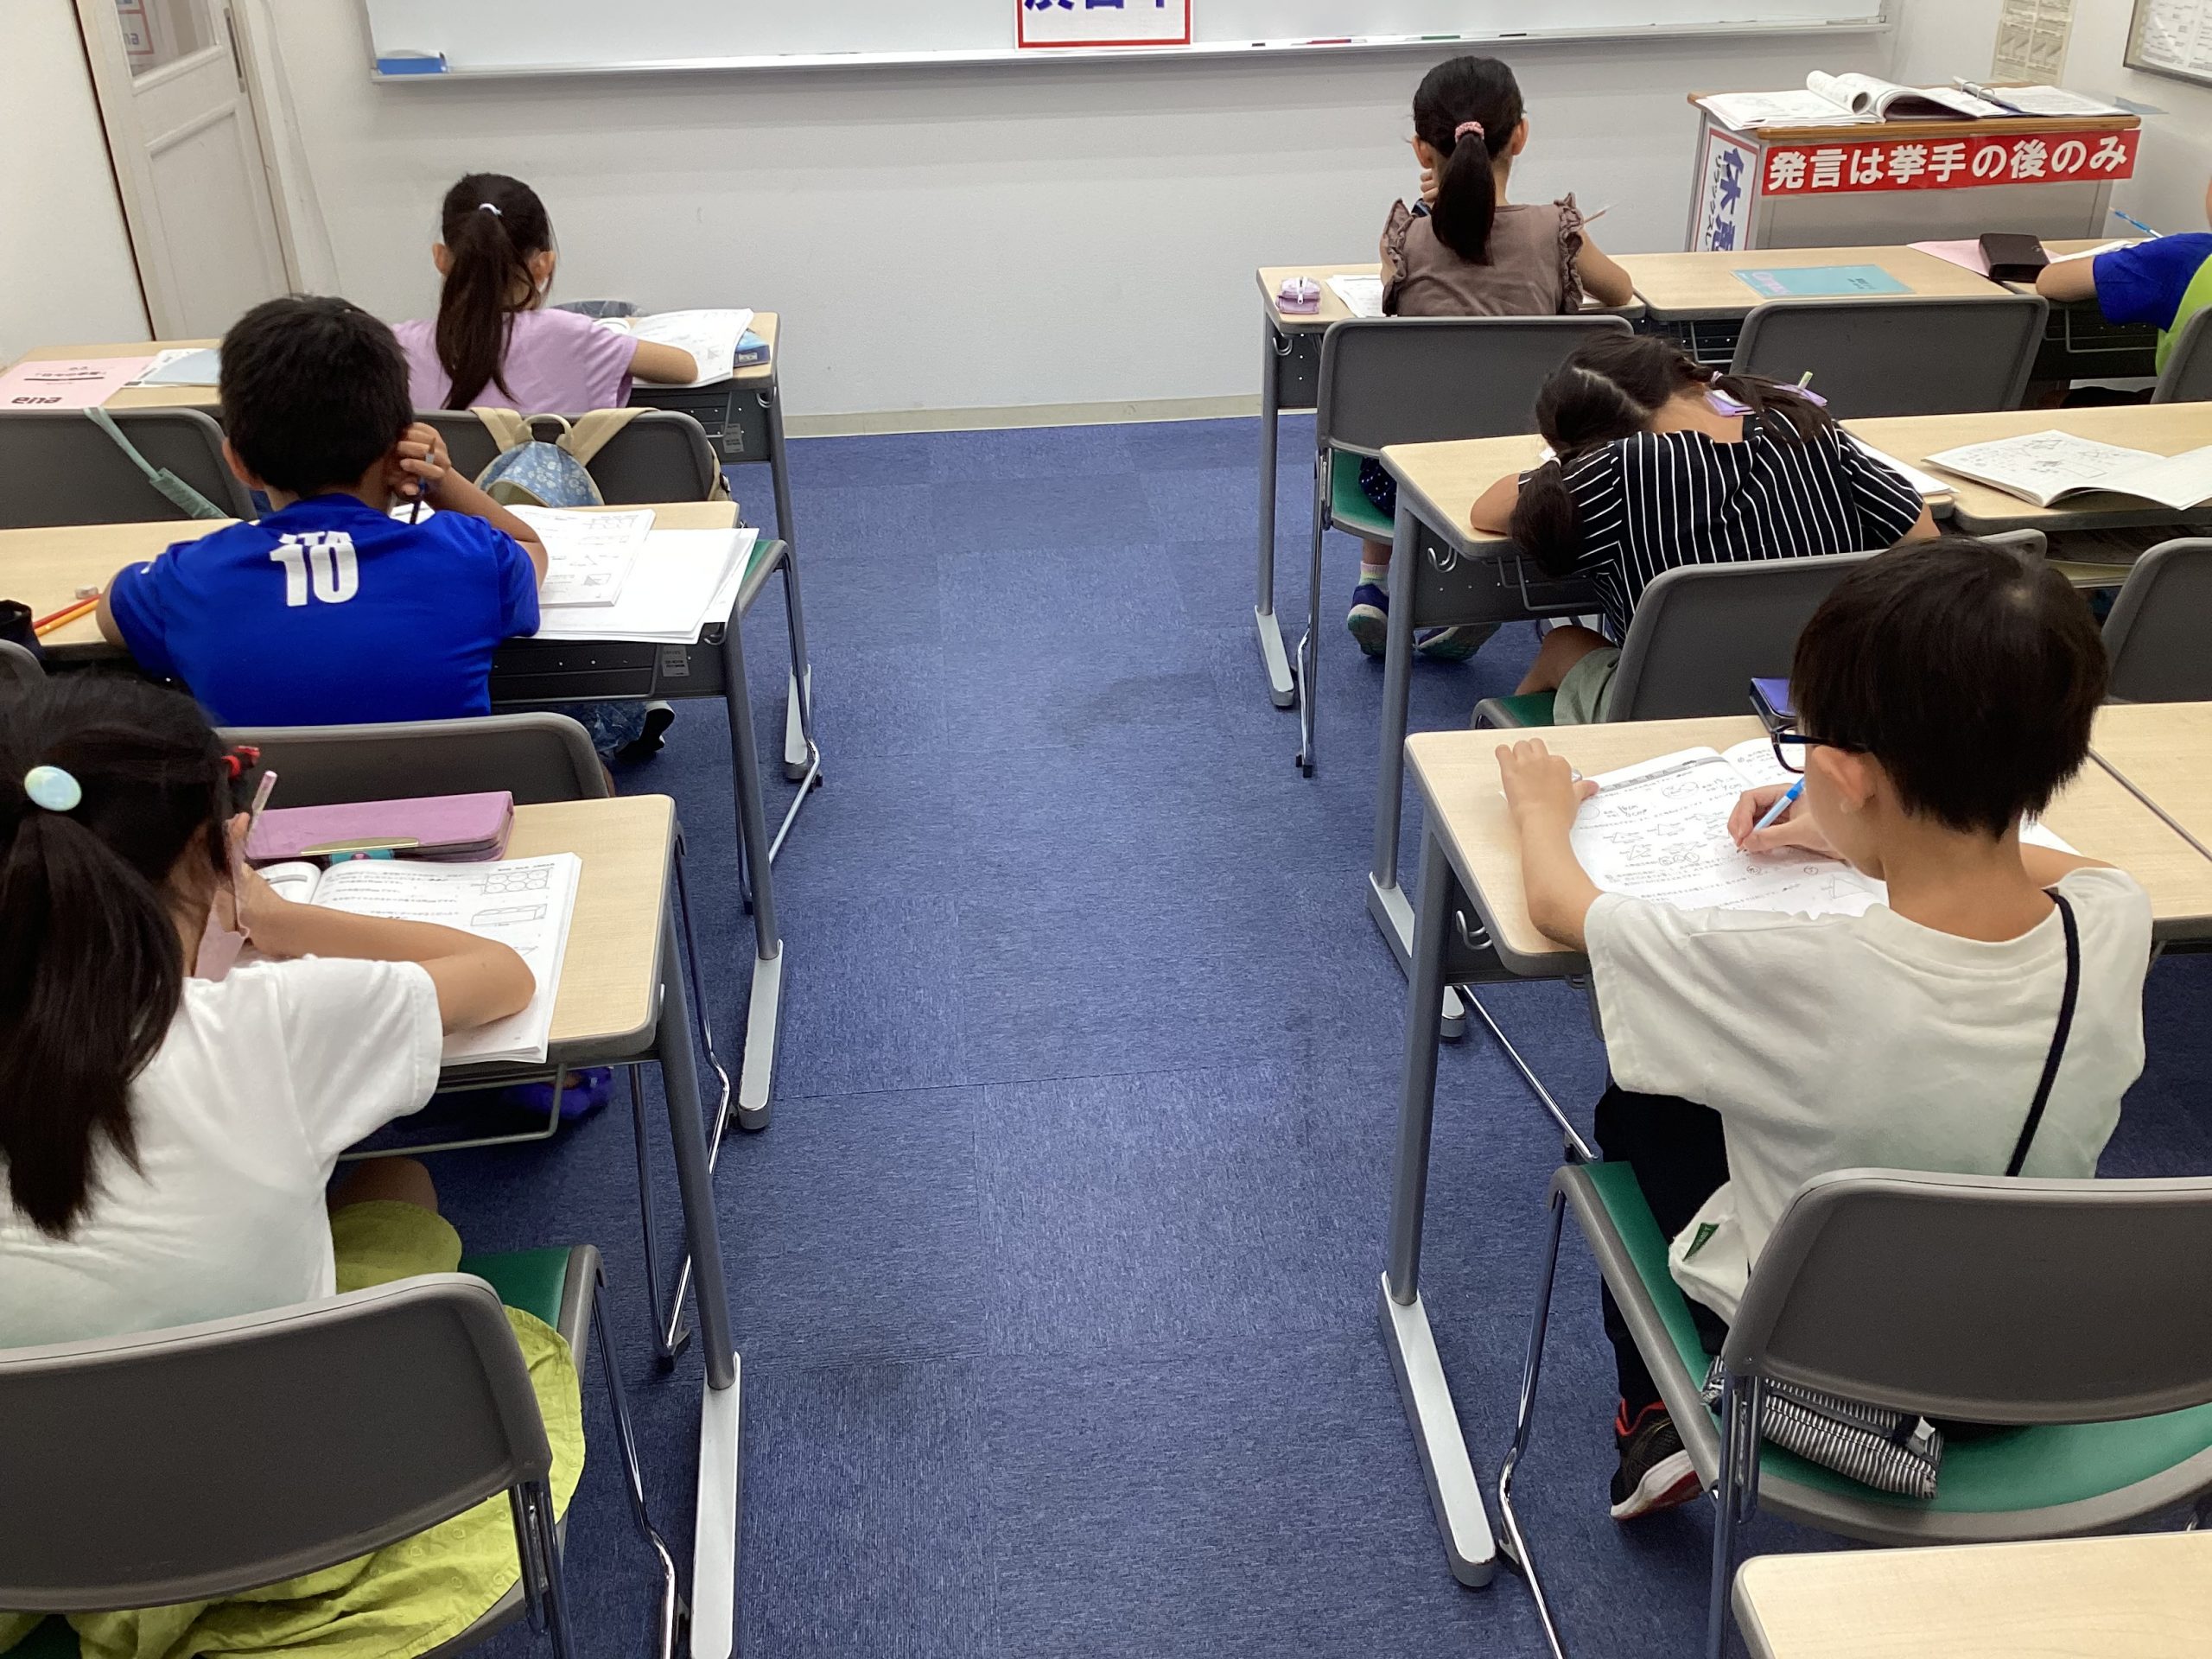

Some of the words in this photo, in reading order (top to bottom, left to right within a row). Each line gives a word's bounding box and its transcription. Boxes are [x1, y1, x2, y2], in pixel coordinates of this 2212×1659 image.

[1768, 135, 2128, 191] 発言は挙手の後のみ
[1705, 155, 1722, 251] リラックスし
[270, 543, 359, 607] 10
